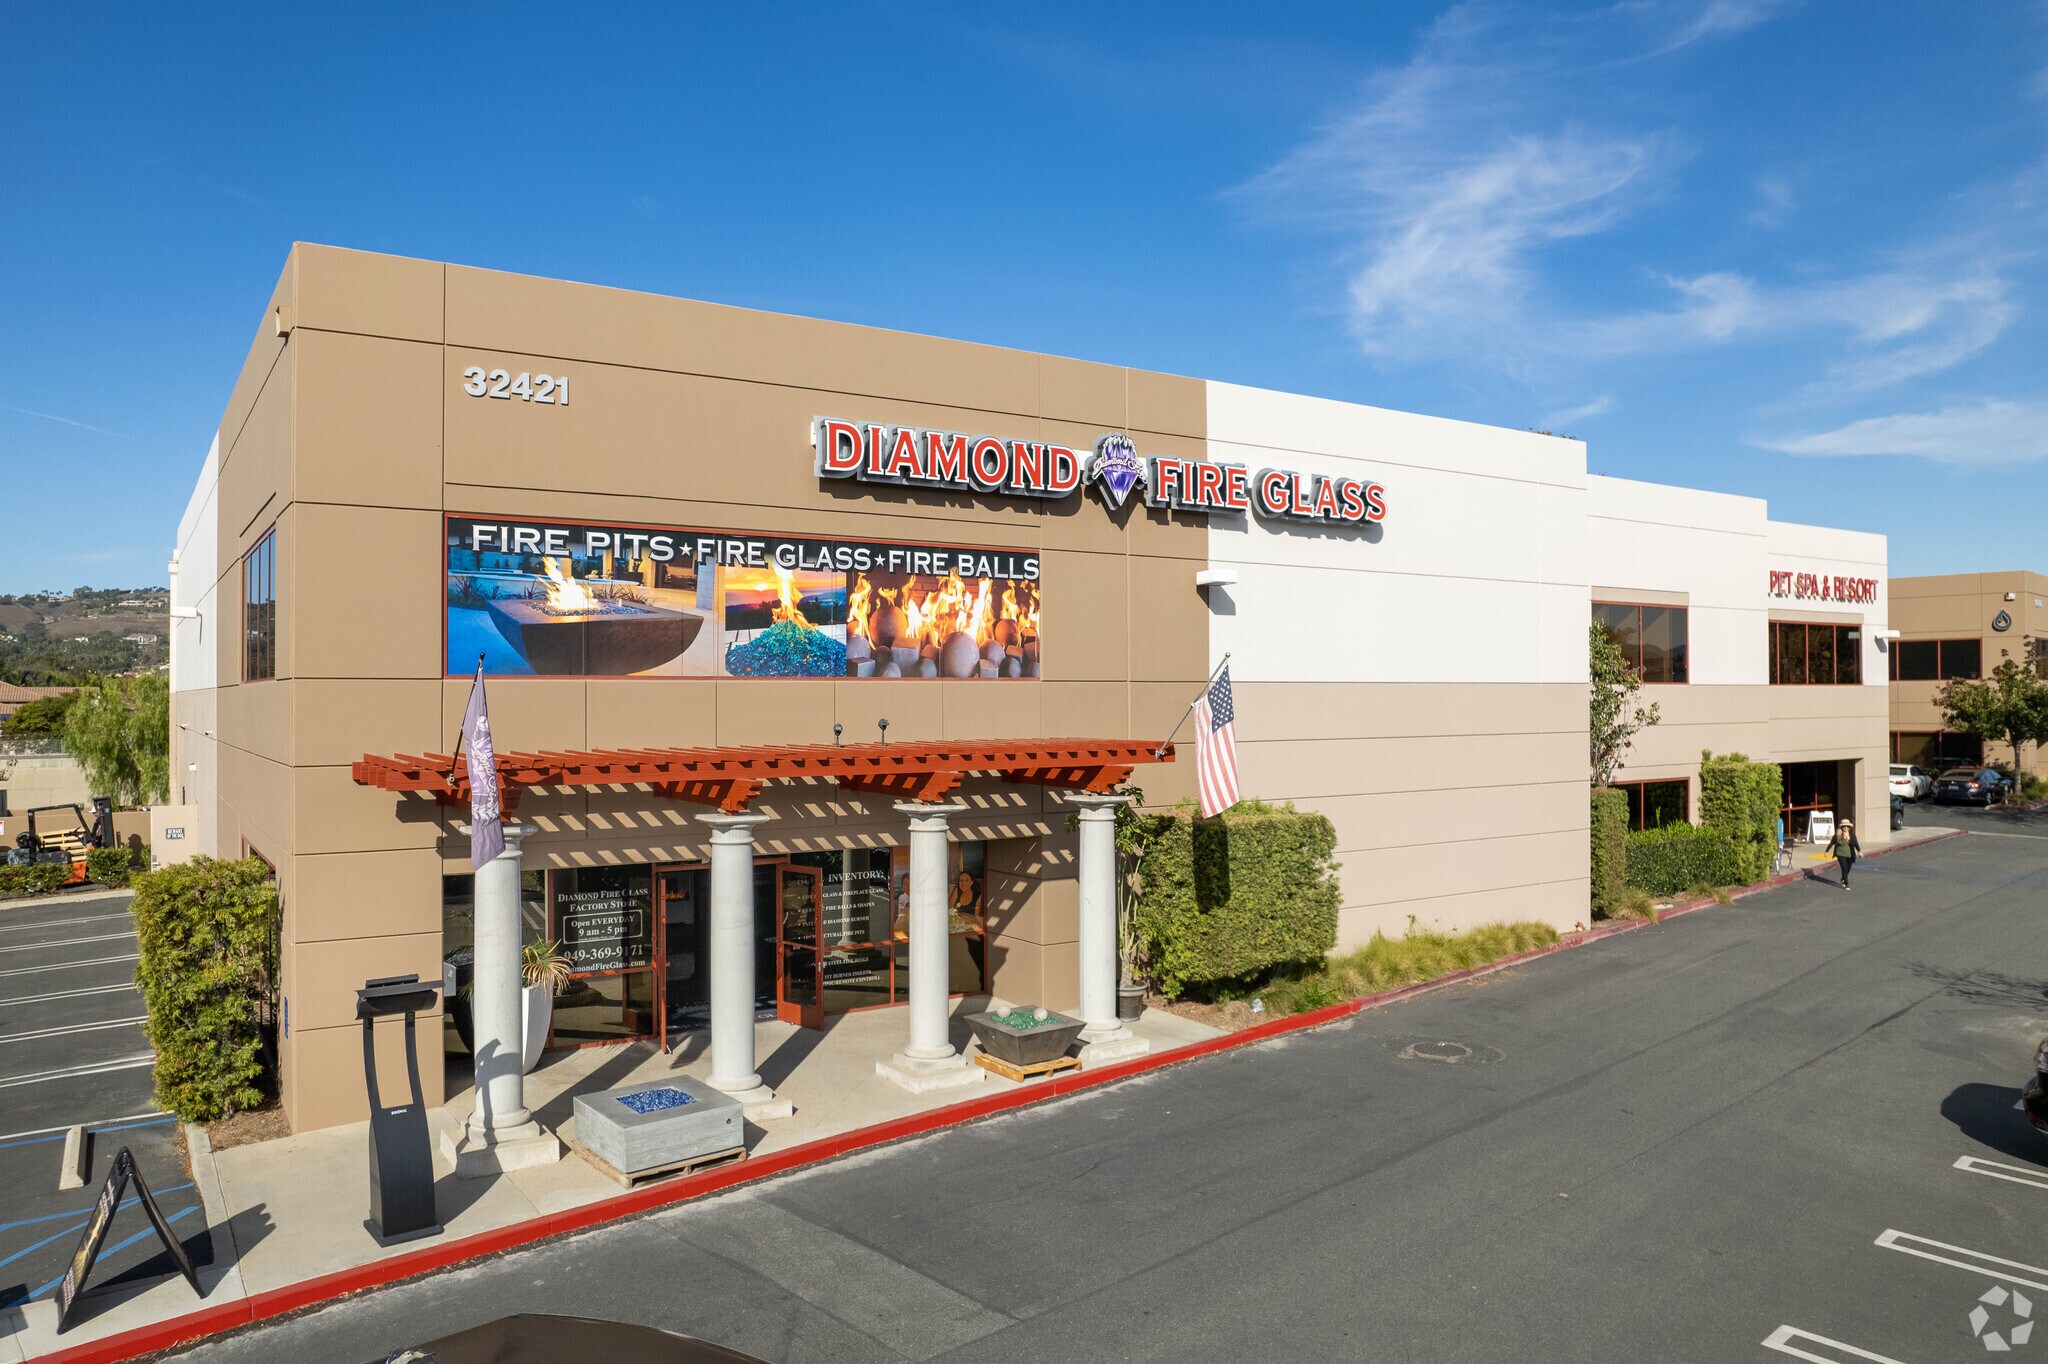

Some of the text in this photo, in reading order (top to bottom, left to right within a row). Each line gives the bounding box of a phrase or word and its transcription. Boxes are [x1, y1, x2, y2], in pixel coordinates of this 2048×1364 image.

[463, 366, 569, 406] 32421
[821, 418, 1081, 494] DIAMOND
[1151, 457, 1249, 509] FIRE
[1261, 471, 1388, 524] GLASS
[471, 524, 1040, 580] FIRE PITS FIRE GLASS FIRE BALLS
[1769, 570, 1879, 600] PET SPA & RESORT
[828, 870, 884, 883] INVENTORY:
[558, 892, 599, 902] DIAMOND
[600, 890, 620, 899] FIRE
[569, 902, 609, 912] FACTORY
[571, 915, 635, 928] Open EVERYDAY
[578, 928, 584, 937] 9
[607, 926, 612, 934] 5
[614, 926, 627, 936] pm
[563, 944, 643, 962] 949-369-9171
